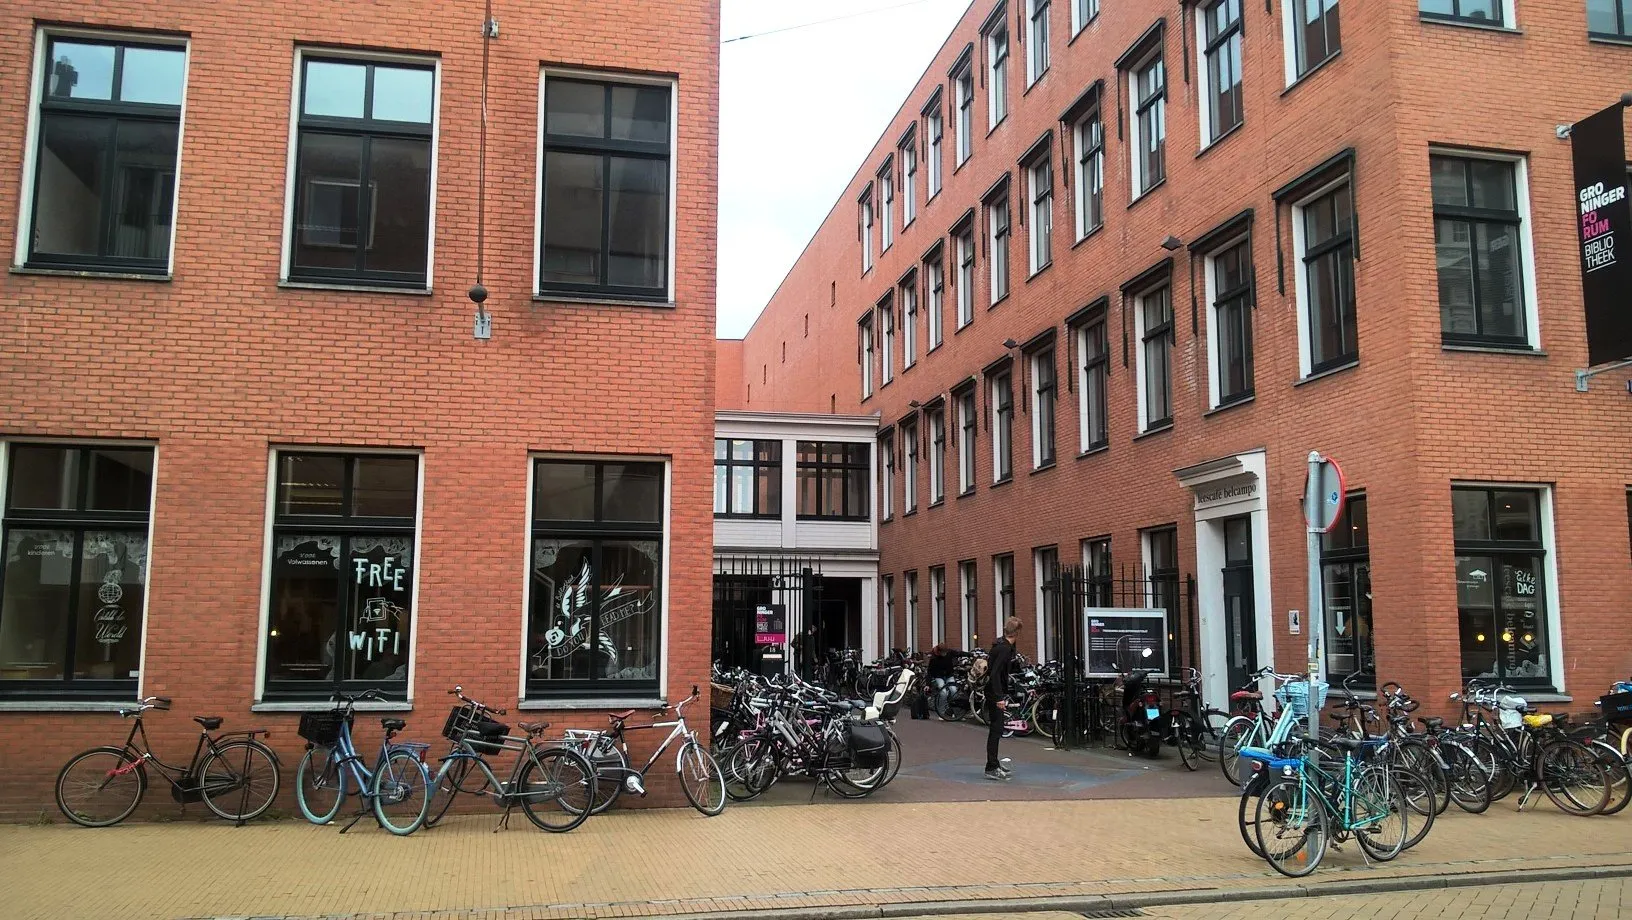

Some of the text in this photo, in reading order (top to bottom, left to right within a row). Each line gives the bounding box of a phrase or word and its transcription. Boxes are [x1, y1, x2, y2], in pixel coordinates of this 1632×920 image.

[1580, 182, 1604, 202] GRO
[1581, 186, 1625, 215] NINGER
[1582, 211, 1598, 227] FO
[1583, 218, 1609, 240] RUM
[1585, 236, 1614, 257] BIBLIO
[1586, 248, 1615, 268] THEEK
[1224, 484, 1257, 498] belcampo
[353, 557, 406, 592] FREE
[1515, 570, 1536, 585] Elke
[1517, 582, 1535, 595] DAG
[349, 628, 400, 661] WIFI
